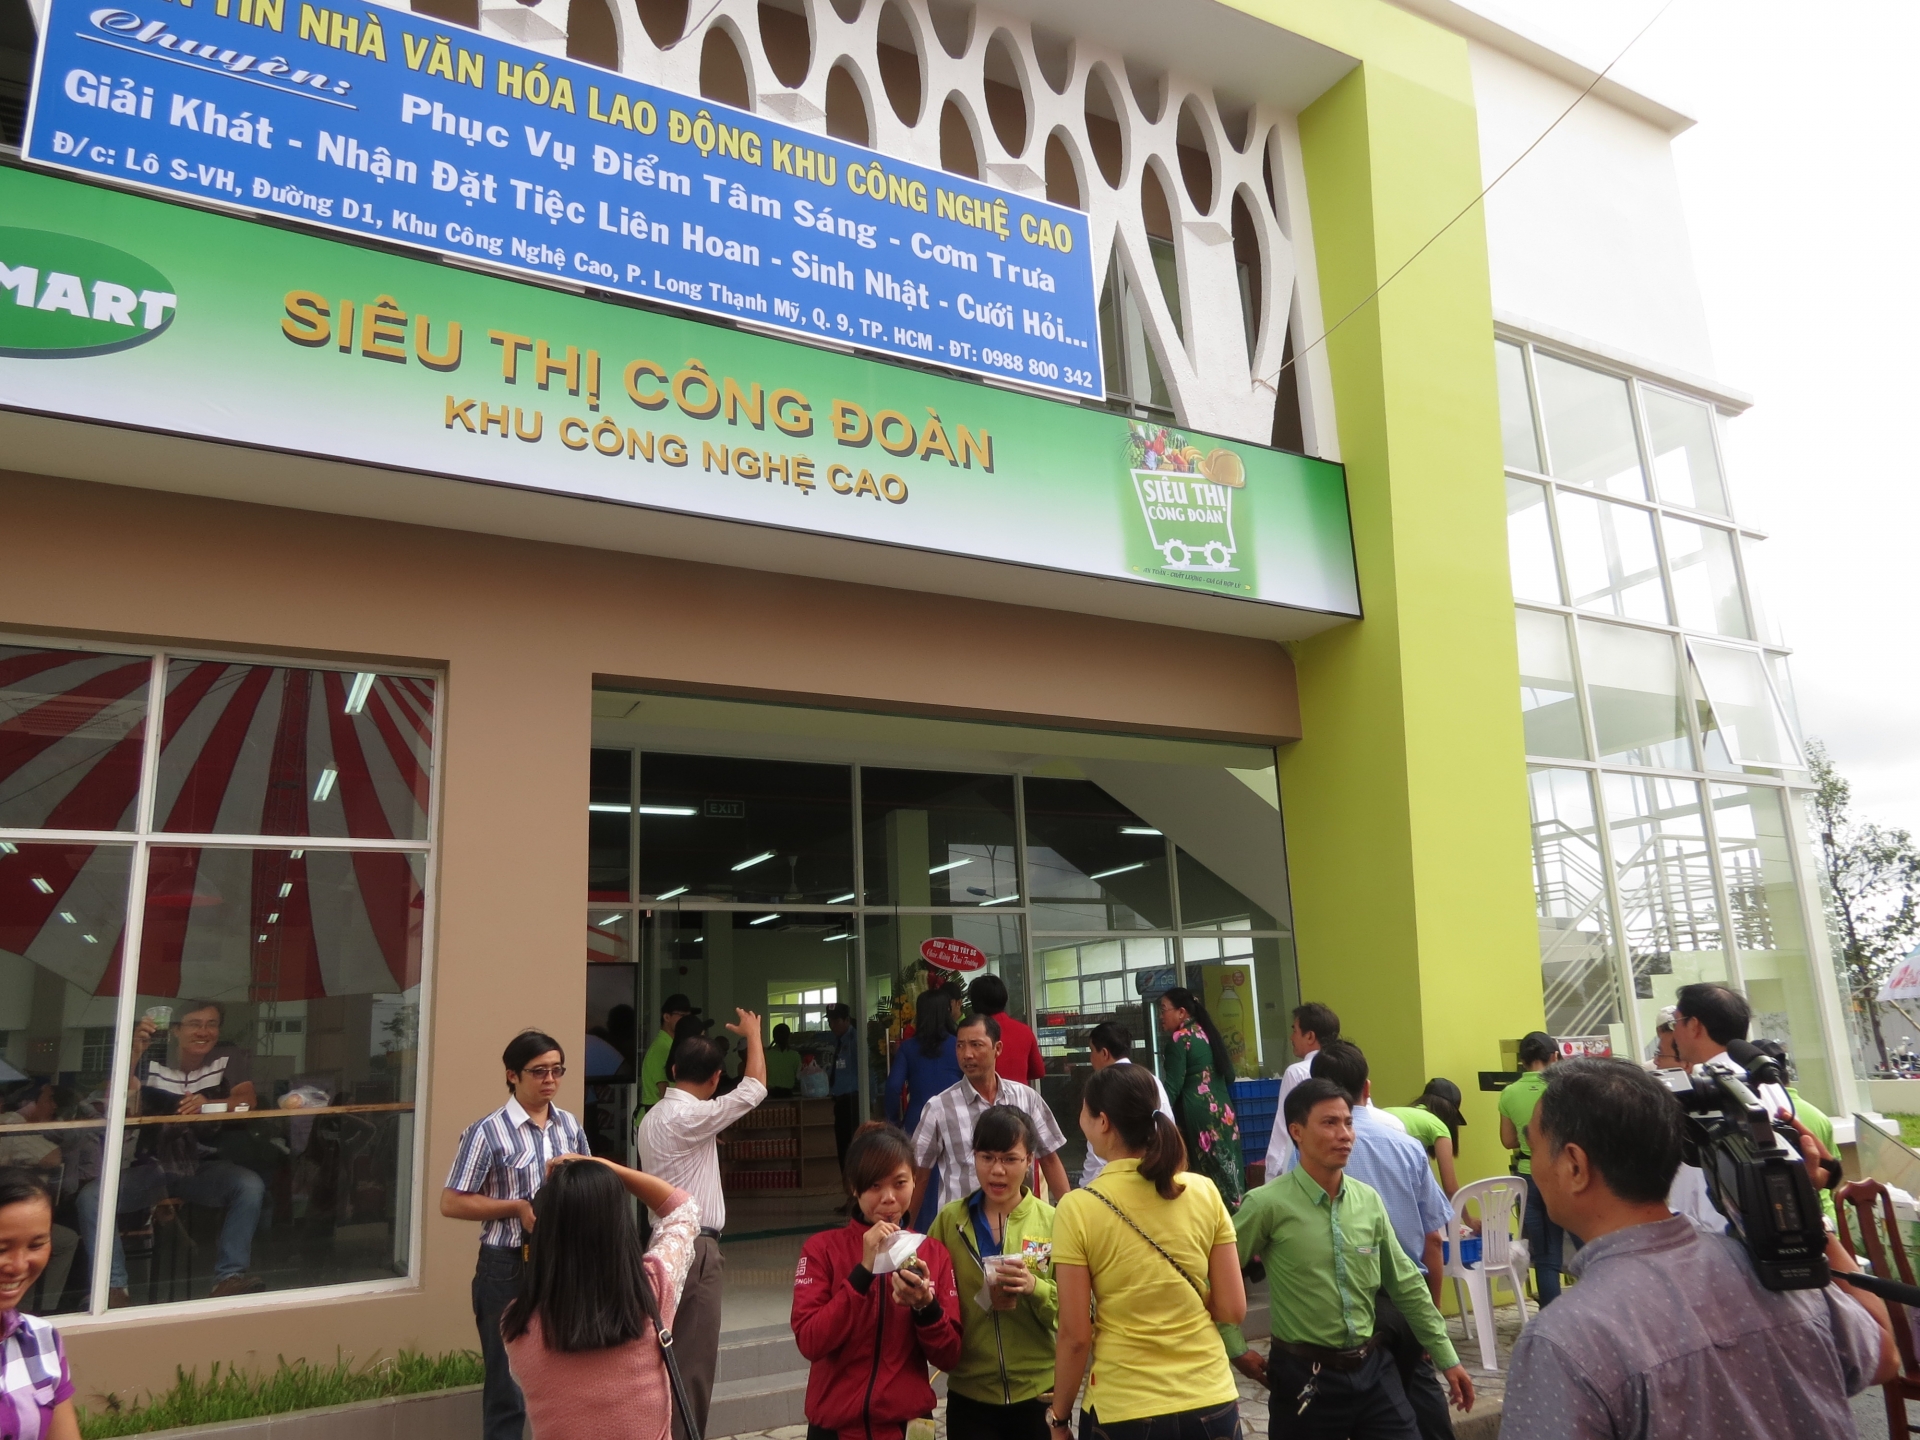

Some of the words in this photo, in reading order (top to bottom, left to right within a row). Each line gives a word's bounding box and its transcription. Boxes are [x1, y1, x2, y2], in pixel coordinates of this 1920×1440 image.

[90, 9, 352, 96] Chuyên:
[299, 4, 388, 62] NHÀ
[402, 32, 485, 89] VĂN
[496, 62, 576, 115] HÓA
[587, 86, 658, 136] LAO
[667, 109, 762, 167] ĐỘNG
[772, 138, 837, 187] KHU
[846, 161, 928, 213] CÔNG
[936, 188, 1010, 241] NGHỆ
[1020, 213, 1073, 254] CAO
[64, 69, 154, 119] Giải
[170, 93, 273, 149] Khát
[317, 130, 417, 184] Nhận
[432, 160, 498, 207] Đặt
[510, 178, 586, 225] Tiệc
[599, 201, 670, 245] Liên
[682, 221, 760, 267] Hoan
[791, 250, 854, 290] Sinh
[865, 268, 930, 311] Nhật
[956, 293, 1014, 330] Cưới
[1022, 308, 1088, 348] Hỏi...
[402, 93, 509, 147] Phục
[524, 125, 576, 171] Vụ
[593, 144, 691, 196] Điểm
[703, 174, 782, 220] Tâm
[793, 199, 877, 249] Sáng
[911, 232, 978, 272] Cơm
[987, 252, 1056, 293] Trưa
[0, 261, 177, 330] MART
[125, 148, 160, 175] Lô
[170, 158, 243, 197] S-VH,
[252, 177, 334, 217] Đường
[342, 197, 383, 229] D1,
[392, 209, 437, 238] Khu
[445, 222, 503, 256] Công
[511, 237, 566, 270] Nghệ
[573, 252, 620, 283] Cao,
[626, 263, 647, 285] P.
[654, 270, 702, 300] Long
[708, 282, 767, 311] Thạnh
[774, 297, 807, 325] Mỹ,
[812, 307, 830, 330] Q.
[836, 313, 854, 336] 9,
[859, 318, 888, 341] TP.
[893, 326, 933, 352] HCM
[949, 340, 977, 362] ĐT:
[982, 348, 1024, 372] 0988
[1028, 358, 1058, 380] 800
[1063, 366, 1093, 388] 342
[280, 289, 462, 372] SIÊU
[488, 329, 600, 411] THỊ
[623, 358, 813, 437] CÔNG
[828, 398, 994, 474] ĐOÀN
[445, 395, 543, 443] KHU
[559, 415, 688, 467] CÔNG
[702, 440, 816, 495] NGHỆ
[826, 463, 908, 505] CAO
[1143, 476, 1188, 504] SIÊU
[1191, 483, 1226, 512] THỊ
[1148, 503, 1185, 521] CÔNG
[1187, 506, 1223, 523] ĐOÀN
[710, 803, 739, 814] EXIT
